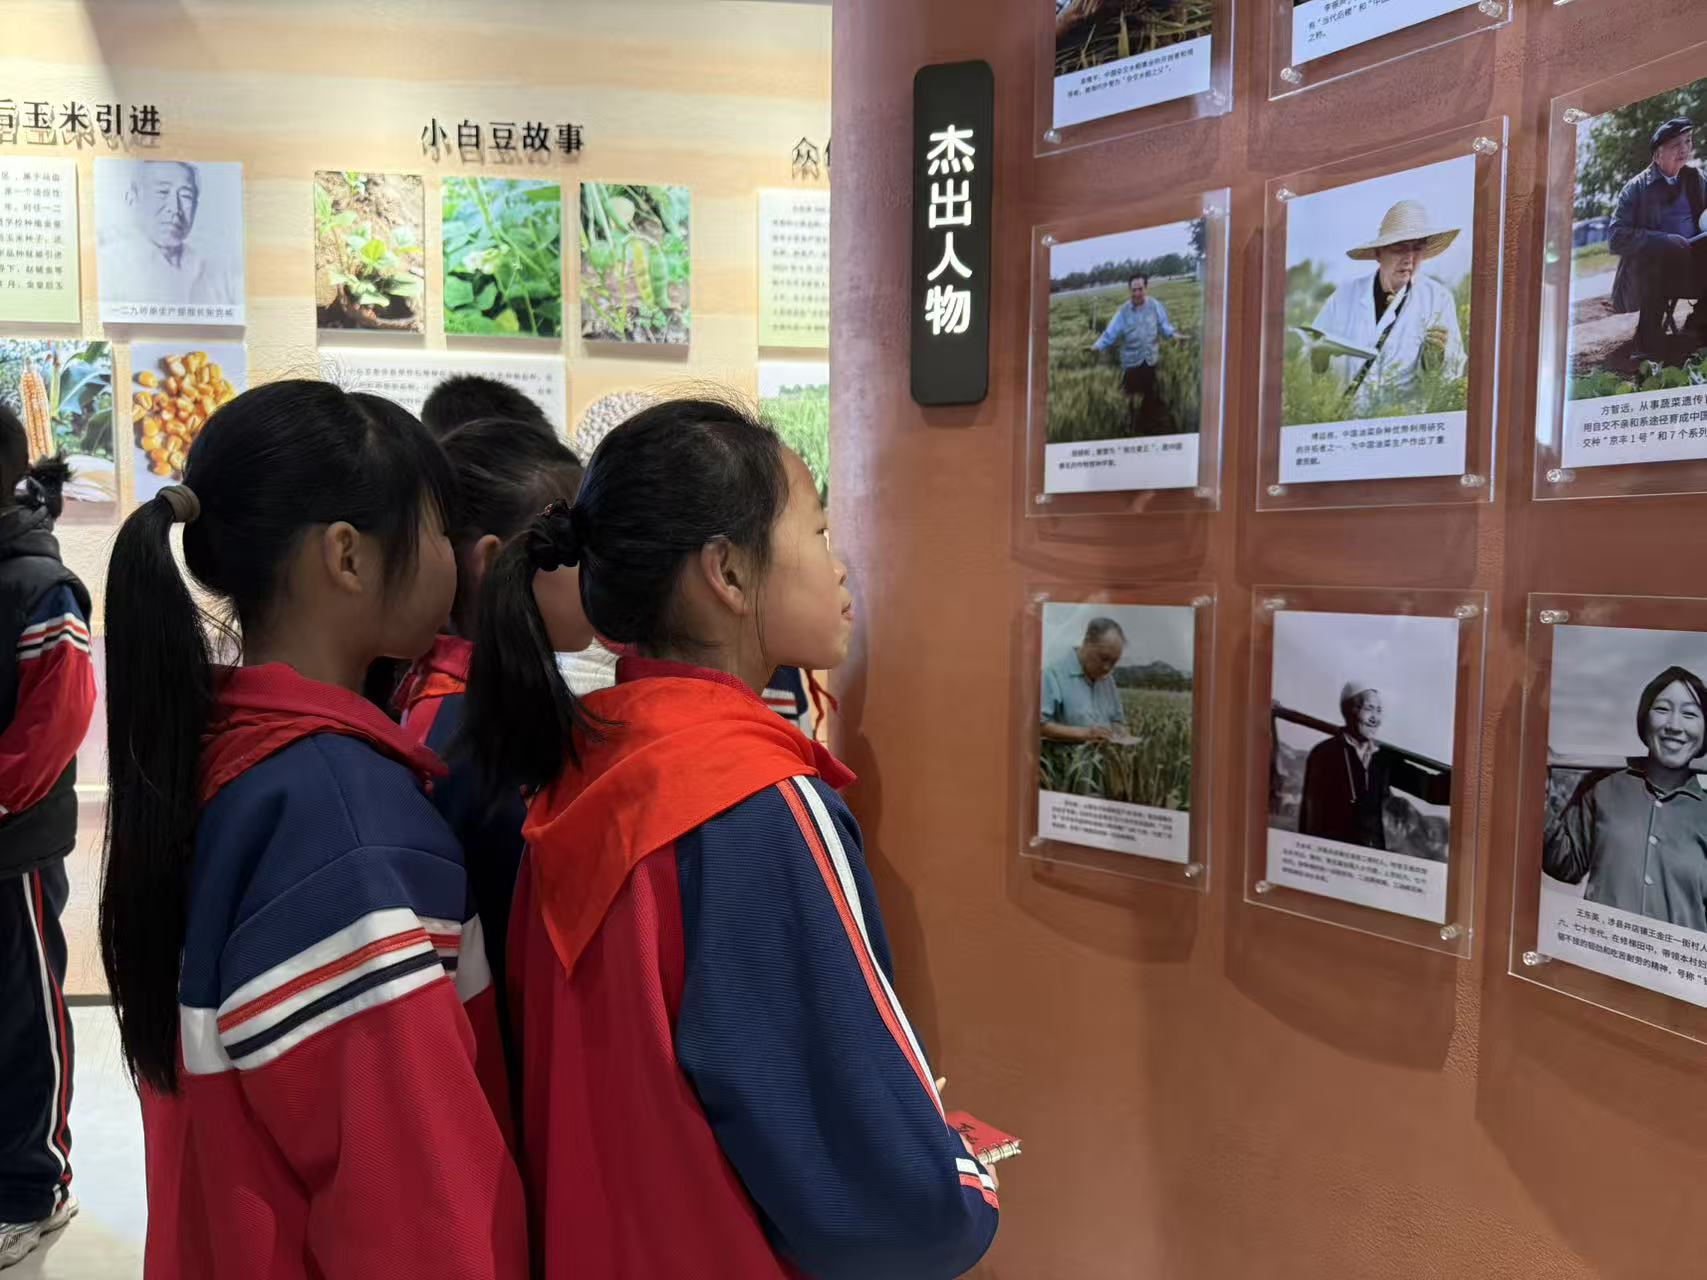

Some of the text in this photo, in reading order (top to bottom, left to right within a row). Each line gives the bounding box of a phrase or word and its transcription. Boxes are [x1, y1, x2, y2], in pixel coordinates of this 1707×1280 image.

[421, 118, 584, 155] 小白豆故事
[792, 136, 831, 167] 众
[925, 124, 976, 335] 杰出人物
